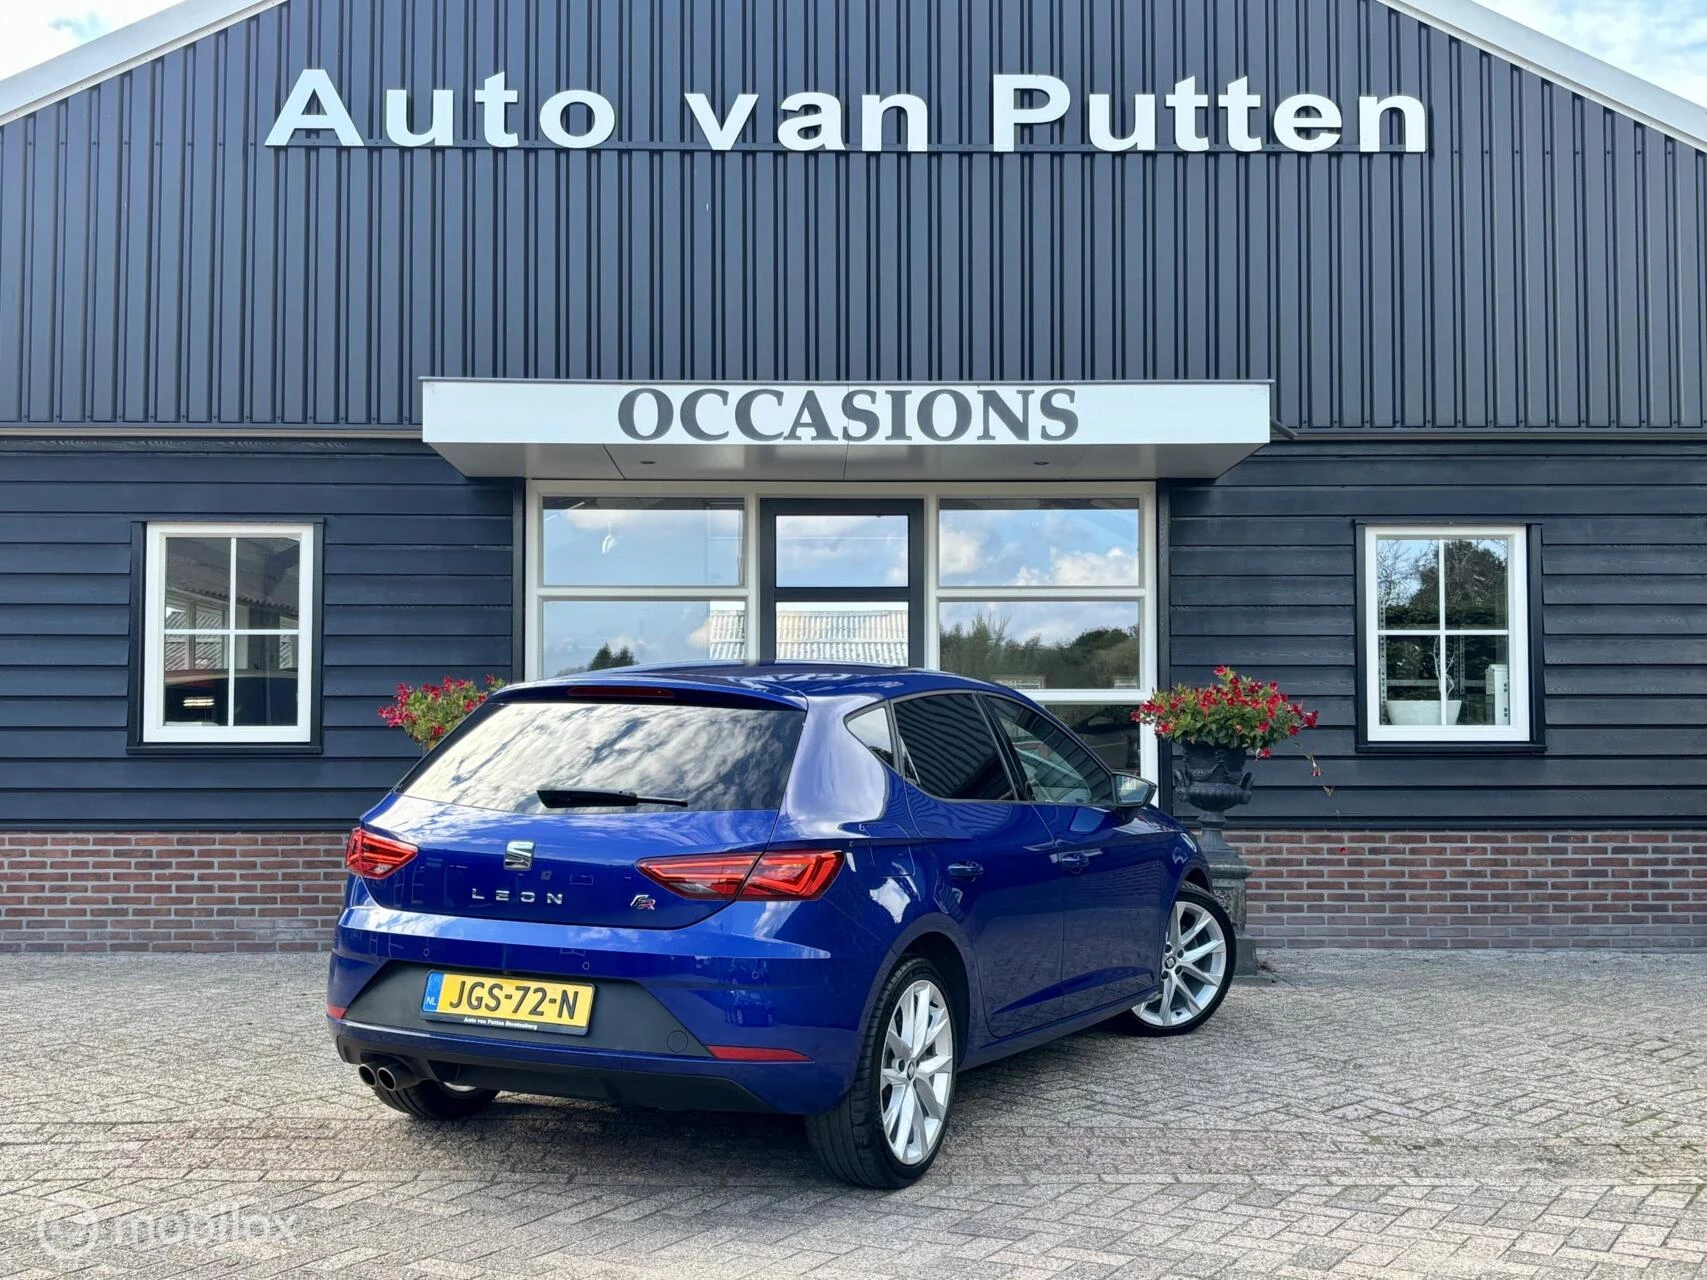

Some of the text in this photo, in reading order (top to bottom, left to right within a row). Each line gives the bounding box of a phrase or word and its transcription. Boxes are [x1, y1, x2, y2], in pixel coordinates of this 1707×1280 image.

[264, 68, 1427, 152] Auto van Putten
[617, 387, 1079, 442] OCCASIONS
[471, 887, 563, 905] LEON
[426, 996, 437, 1006] NL
[449, 980, 579, 1020] JGS-72-N
[487, 1018, 505, 1026] Putten
